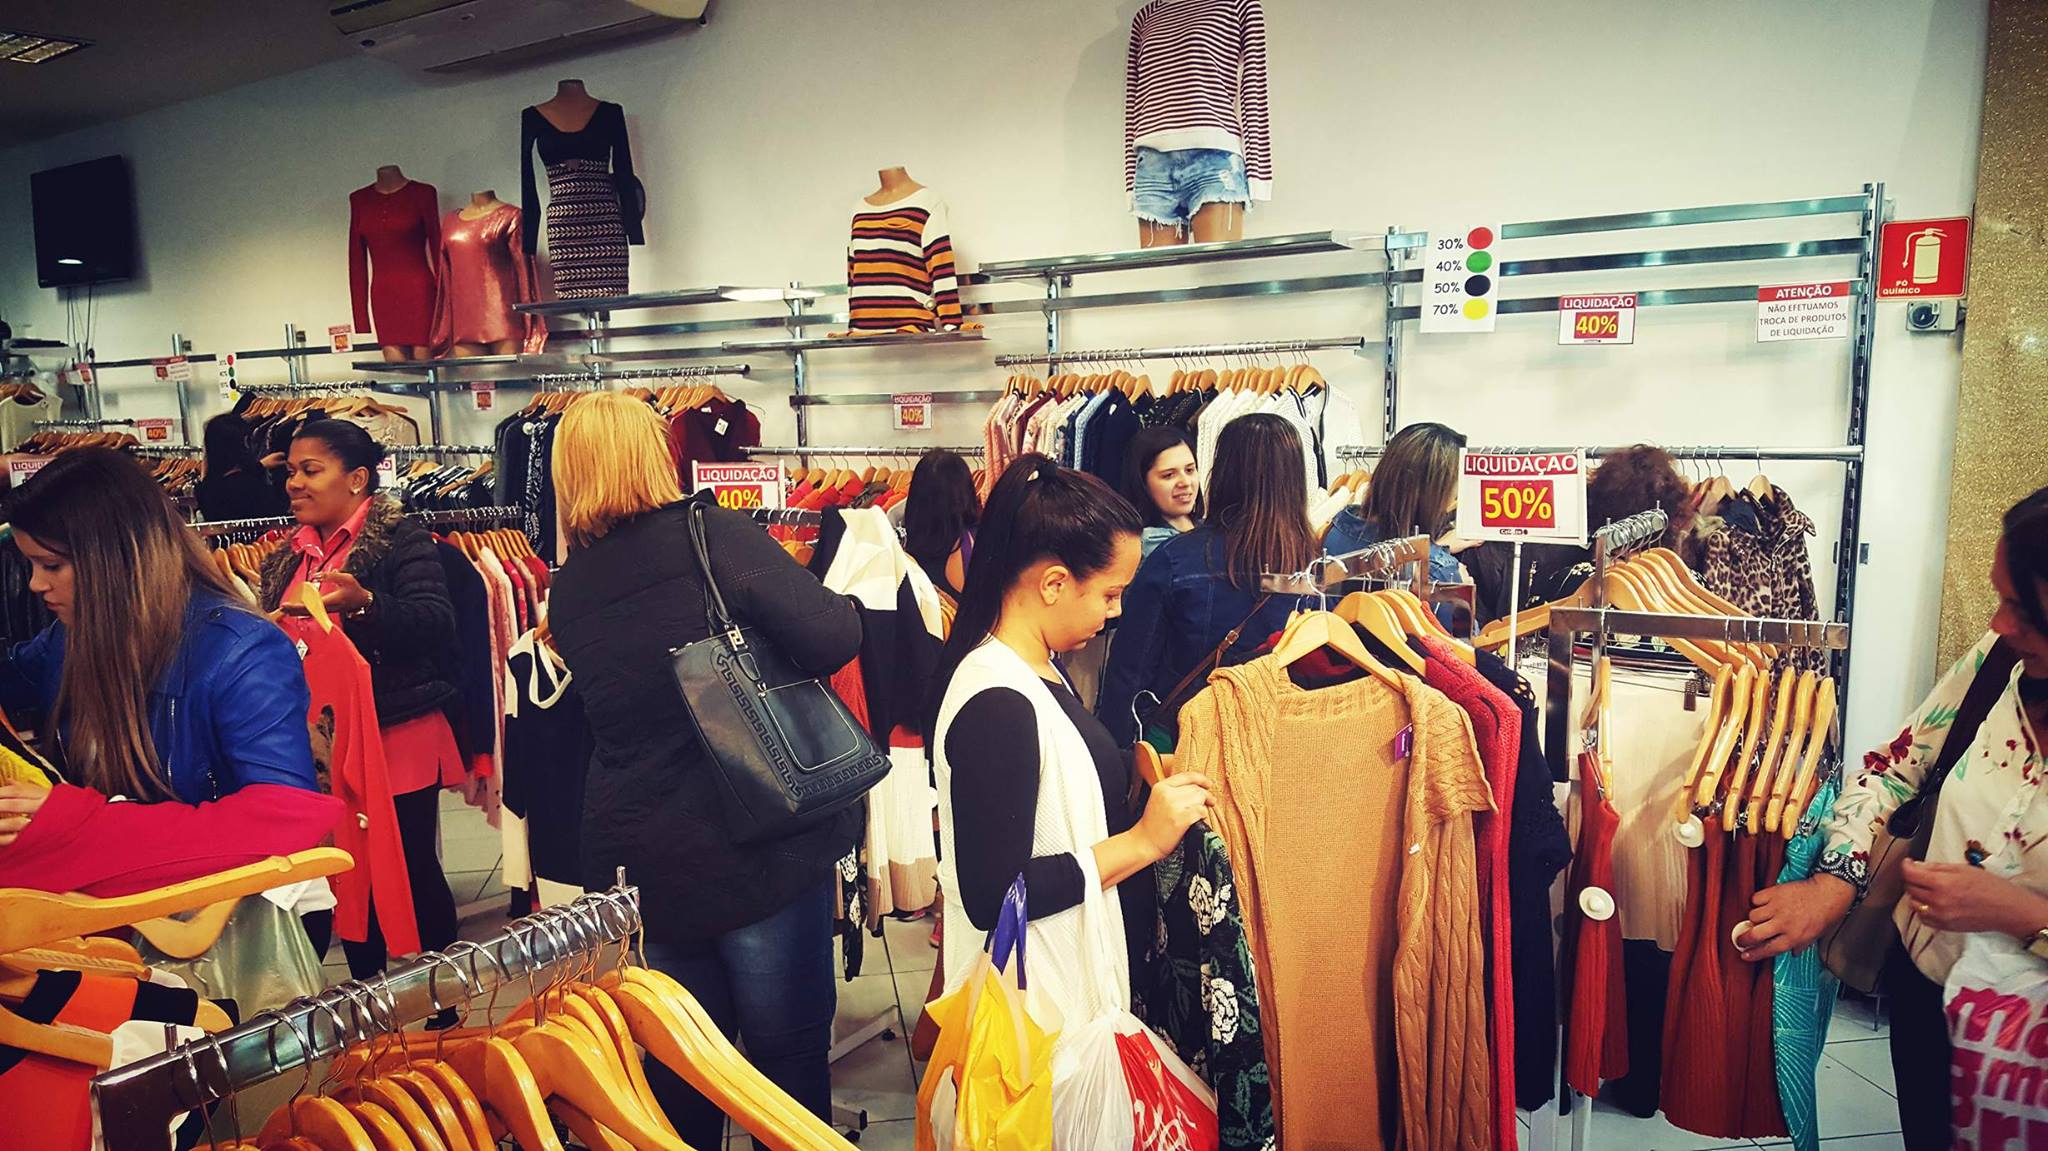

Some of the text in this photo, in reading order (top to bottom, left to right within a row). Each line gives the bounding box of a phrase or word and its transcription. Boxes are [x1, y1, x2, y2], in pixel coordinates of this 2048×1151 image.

[1437, 238, 1464, 250] 30%
[1436, 260, 1462, 272] 40%
[1434, 282, 1460, 293] 50%
[1775, 284, 1832, 298] ATENÇÃO
[1564, 295, 1634, 309] LIQUIDAÇÃO
[1767, 301, 1839, 313] NÃO EFETUAMOS
[1433, 303, 1458, 315] 70%
[1576, 315, 1617, 335] 40%
[1760, 313, 1847, 326] TROCA DE PRODUTOS
[1770, 325, 1834, 337] DE LIQUIDAÇÃO
[902, 408, 923, 423] 40%
[700, 466, 776, 482] LIQUIDAÇÃO
[718, 489, 761, 510] 40%
[1485, 487, 1552, 519] 50%
